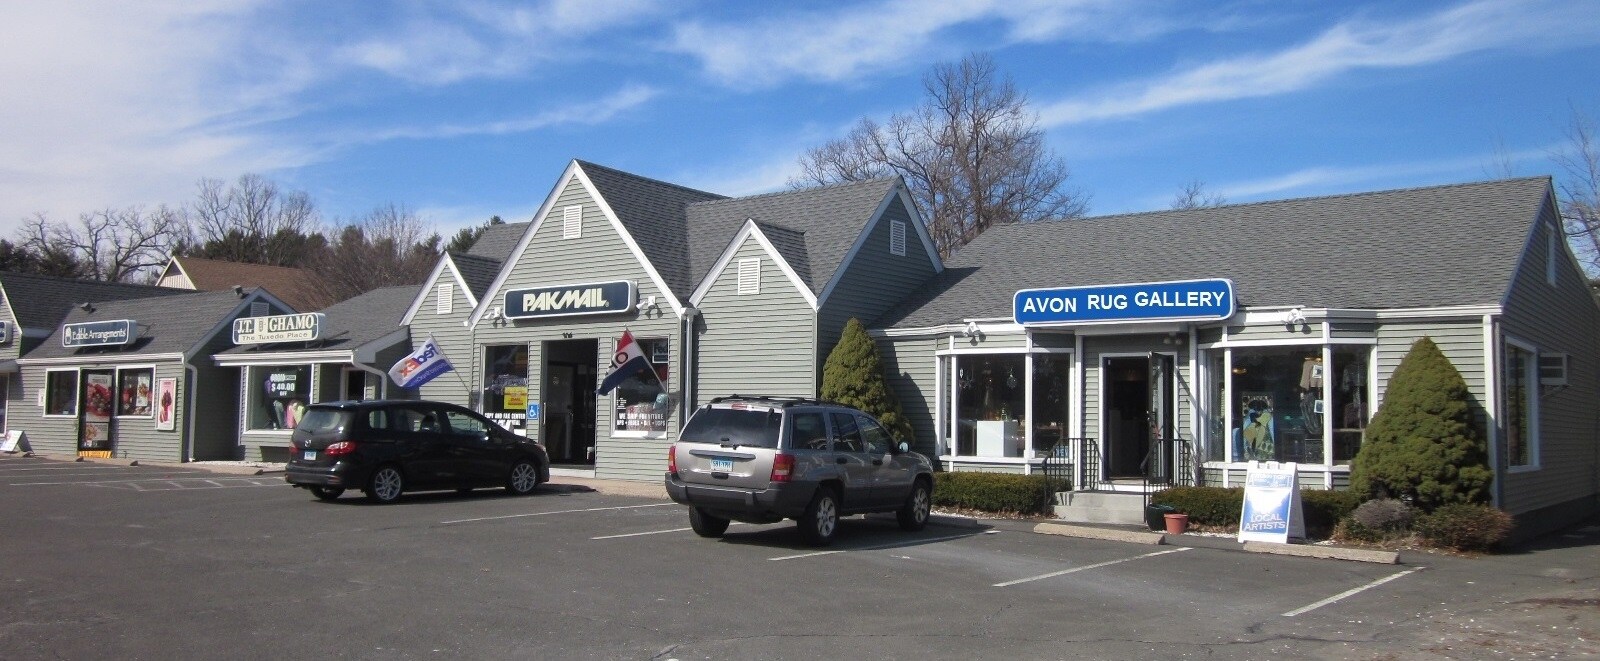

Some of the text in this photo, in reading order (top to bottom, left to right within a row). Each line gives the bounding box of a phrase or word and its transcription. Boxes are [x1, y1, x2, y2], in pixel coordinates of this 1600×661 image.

[1022, 291, 1226, 313] AVON RUG GALLERY
[237, 314, 315, 334] J.T. GHAMO
[72, 327, 127, 343] Edible Arrangements
[1251, 513, 1283, 523] LOCAL
[1244, 521, 1286, 532] ARTISTS
